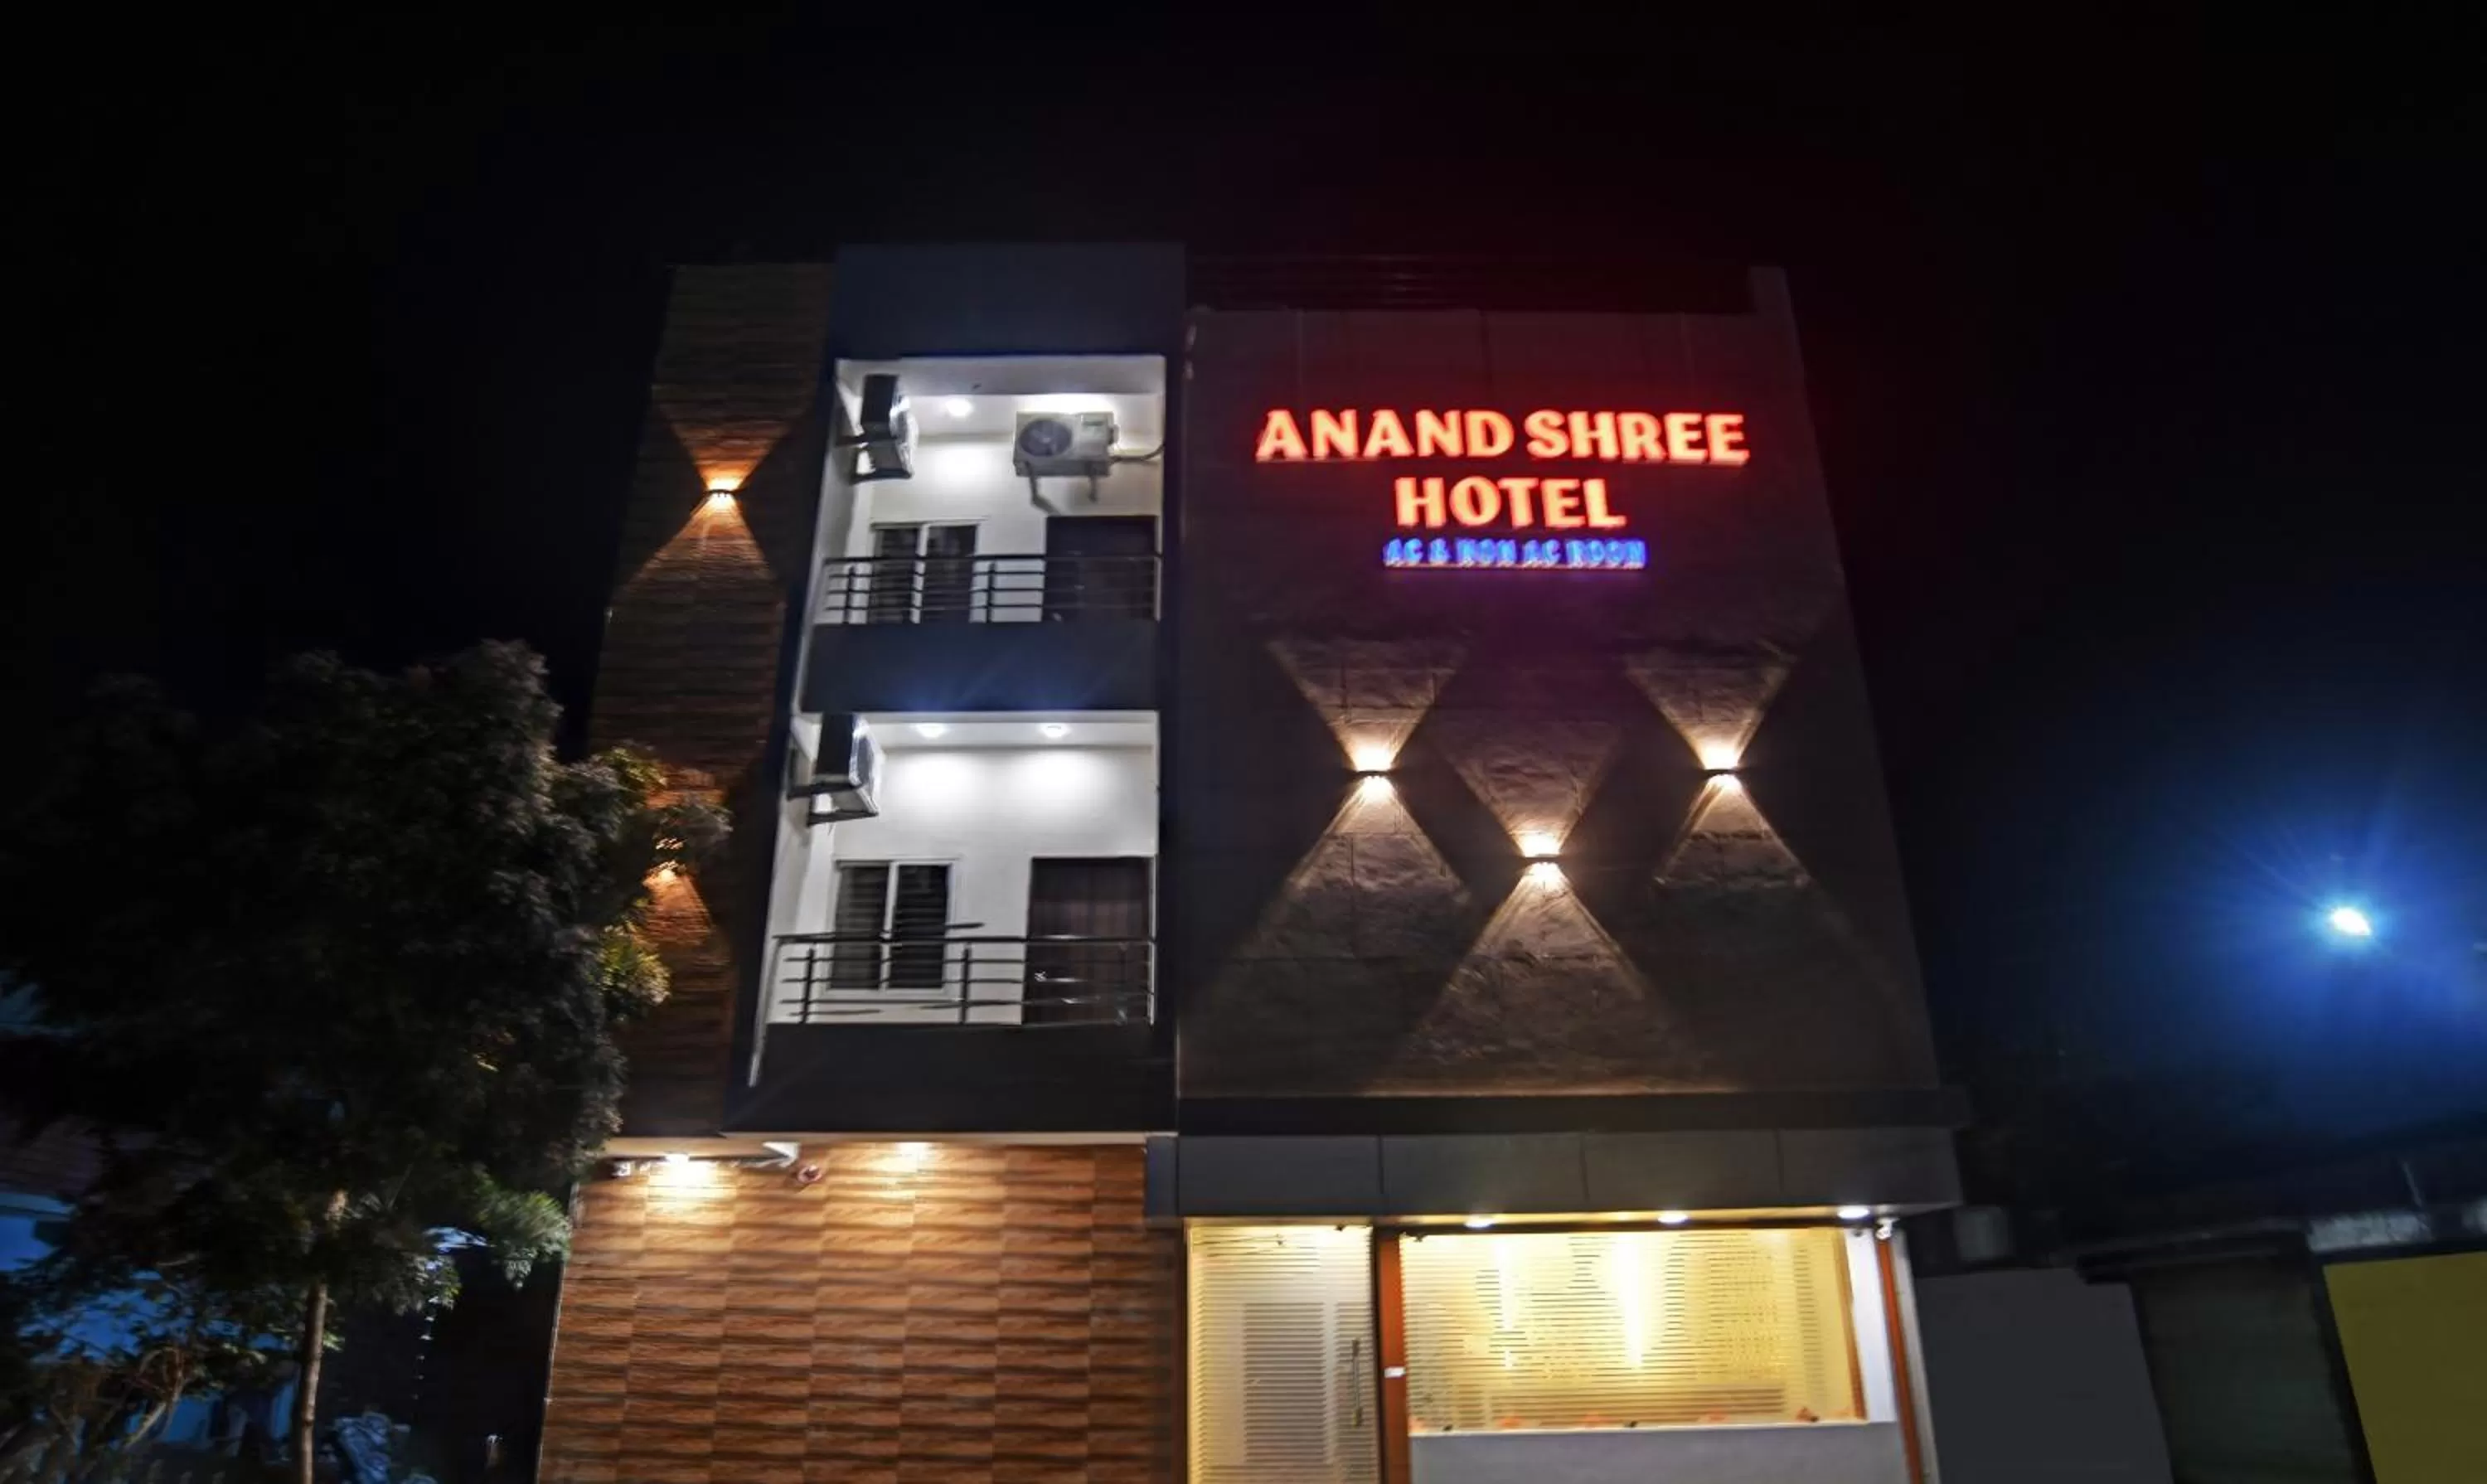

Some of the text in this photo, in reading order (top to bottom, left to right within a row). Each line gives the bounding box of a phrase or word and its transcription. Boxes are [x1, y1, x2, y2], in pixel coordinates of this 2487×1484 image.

[1255, 409, 1750, 465] ANAND SHREE
[1394, 475, 1627, 529] HOTEL
[1383, 537, 1423, 568] AC
[1428, 538, 1450, 566] &
[1455, 538, 1517, 568] NON
[1522, 539, 1561, 569] AC
